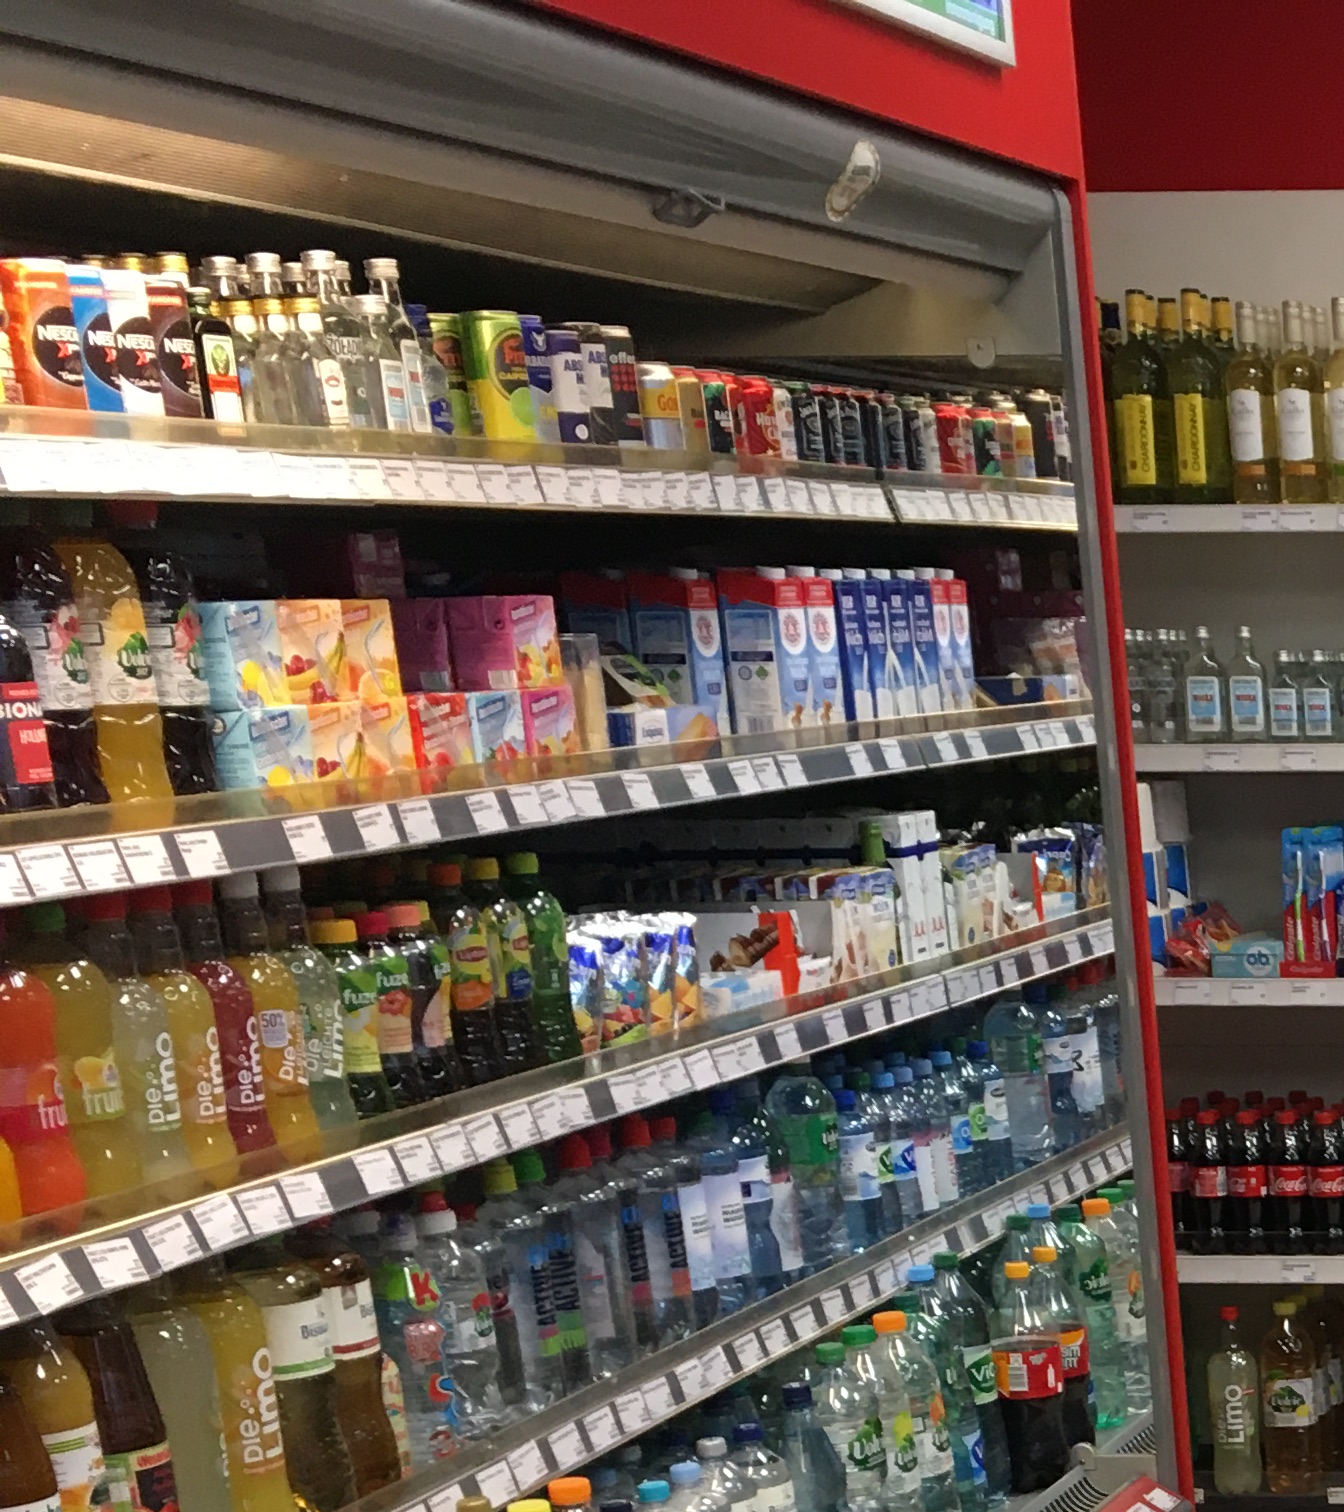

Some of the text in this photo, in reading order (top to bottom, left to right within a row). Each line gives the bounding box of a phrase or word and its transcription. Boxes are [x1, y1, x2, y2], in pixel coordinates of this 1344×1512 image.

[36, 324, 81, 344] NESC
[116, 333, 155, 351] NESC
[1138, 403, 1151, 474] CHARDONNAY
[1190, 400, 1203, 473] CHARDONNAY
